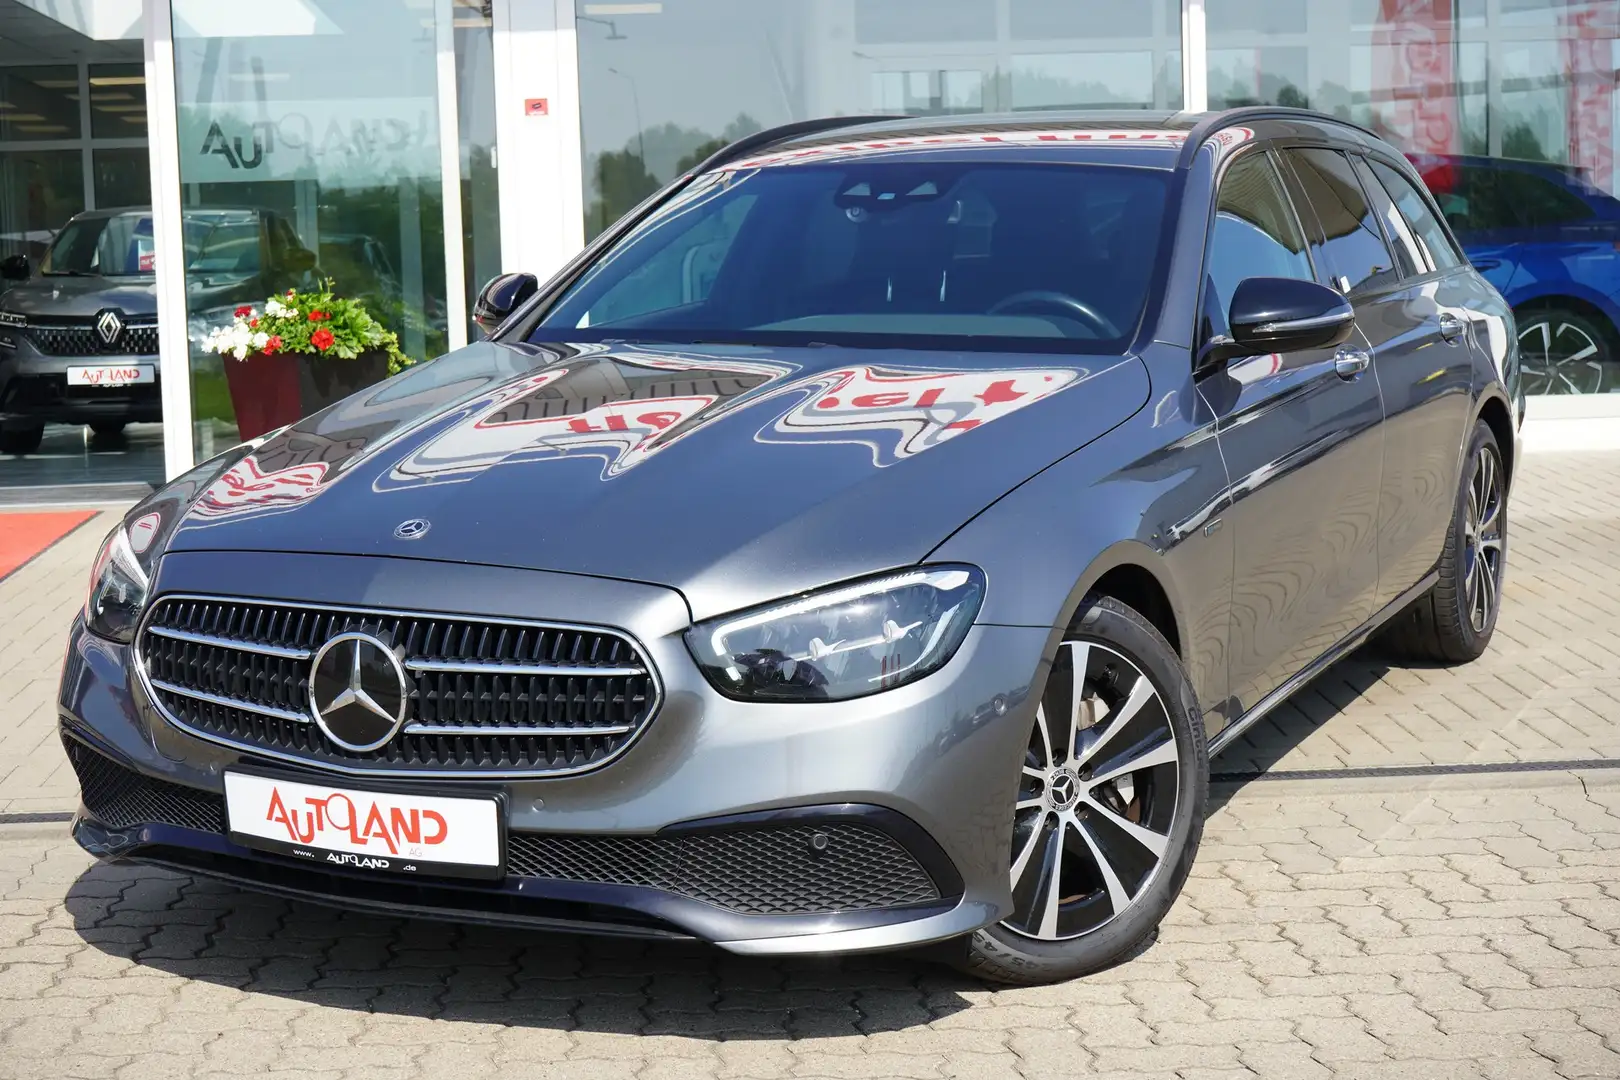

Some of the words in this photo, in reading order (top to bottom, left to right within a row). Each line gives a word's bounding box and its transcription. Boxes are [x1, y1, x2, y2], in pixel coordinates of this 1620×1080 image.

[82, 367, 140, 384] AUTLAND
[266, 786, 448, 855] AUTOLAND
[293, 849, 315, 858] www.
[326, 853, 390, 869] AUTOLAND
[403, 864, 417, 872] .de
[409, 848, 423, 858] AG
